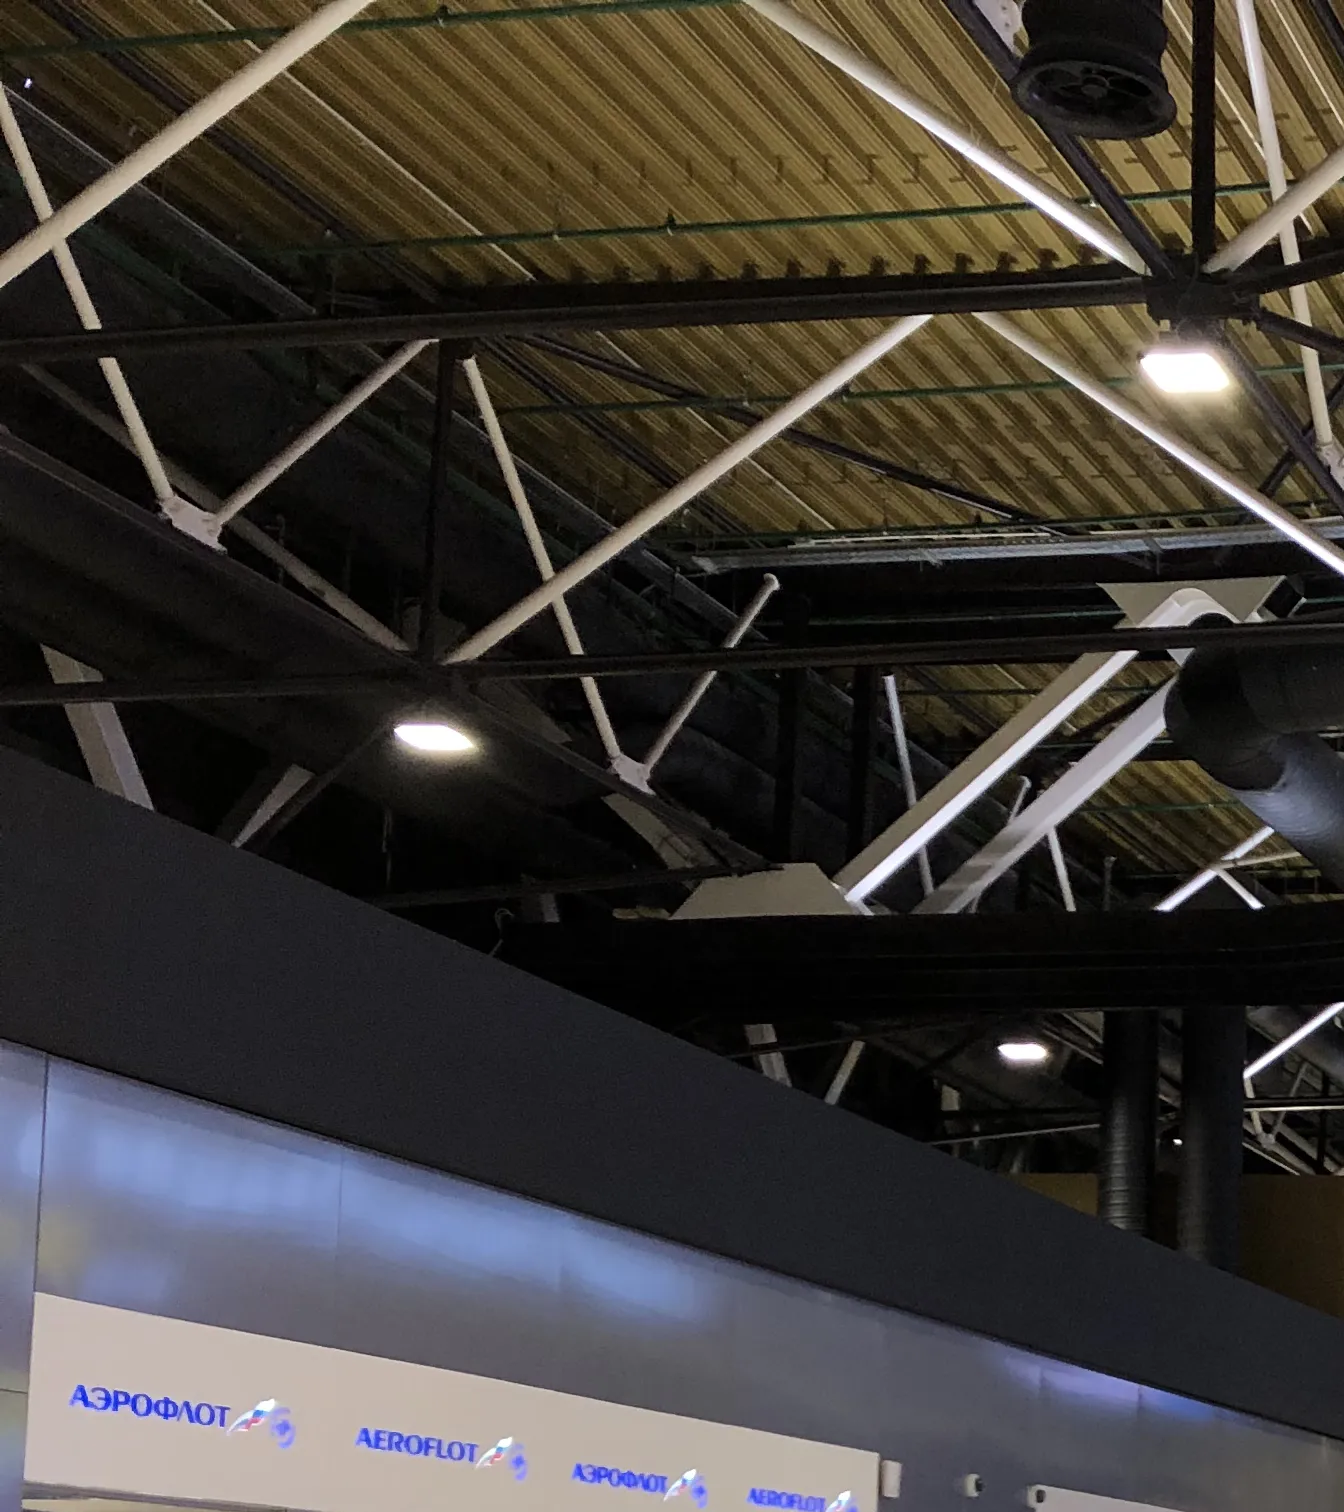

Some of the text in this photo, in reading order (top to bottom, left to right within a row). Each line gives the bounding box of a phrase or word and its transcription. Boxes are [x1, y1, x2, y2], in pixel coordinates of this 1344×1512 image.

[69, 1384, 231, 1429] АЭРОФЛОТ
[354, 1426, 480, 1463] AEROFLOT
[571, 1463, 668, 1494] АЭРОФЛОТ
